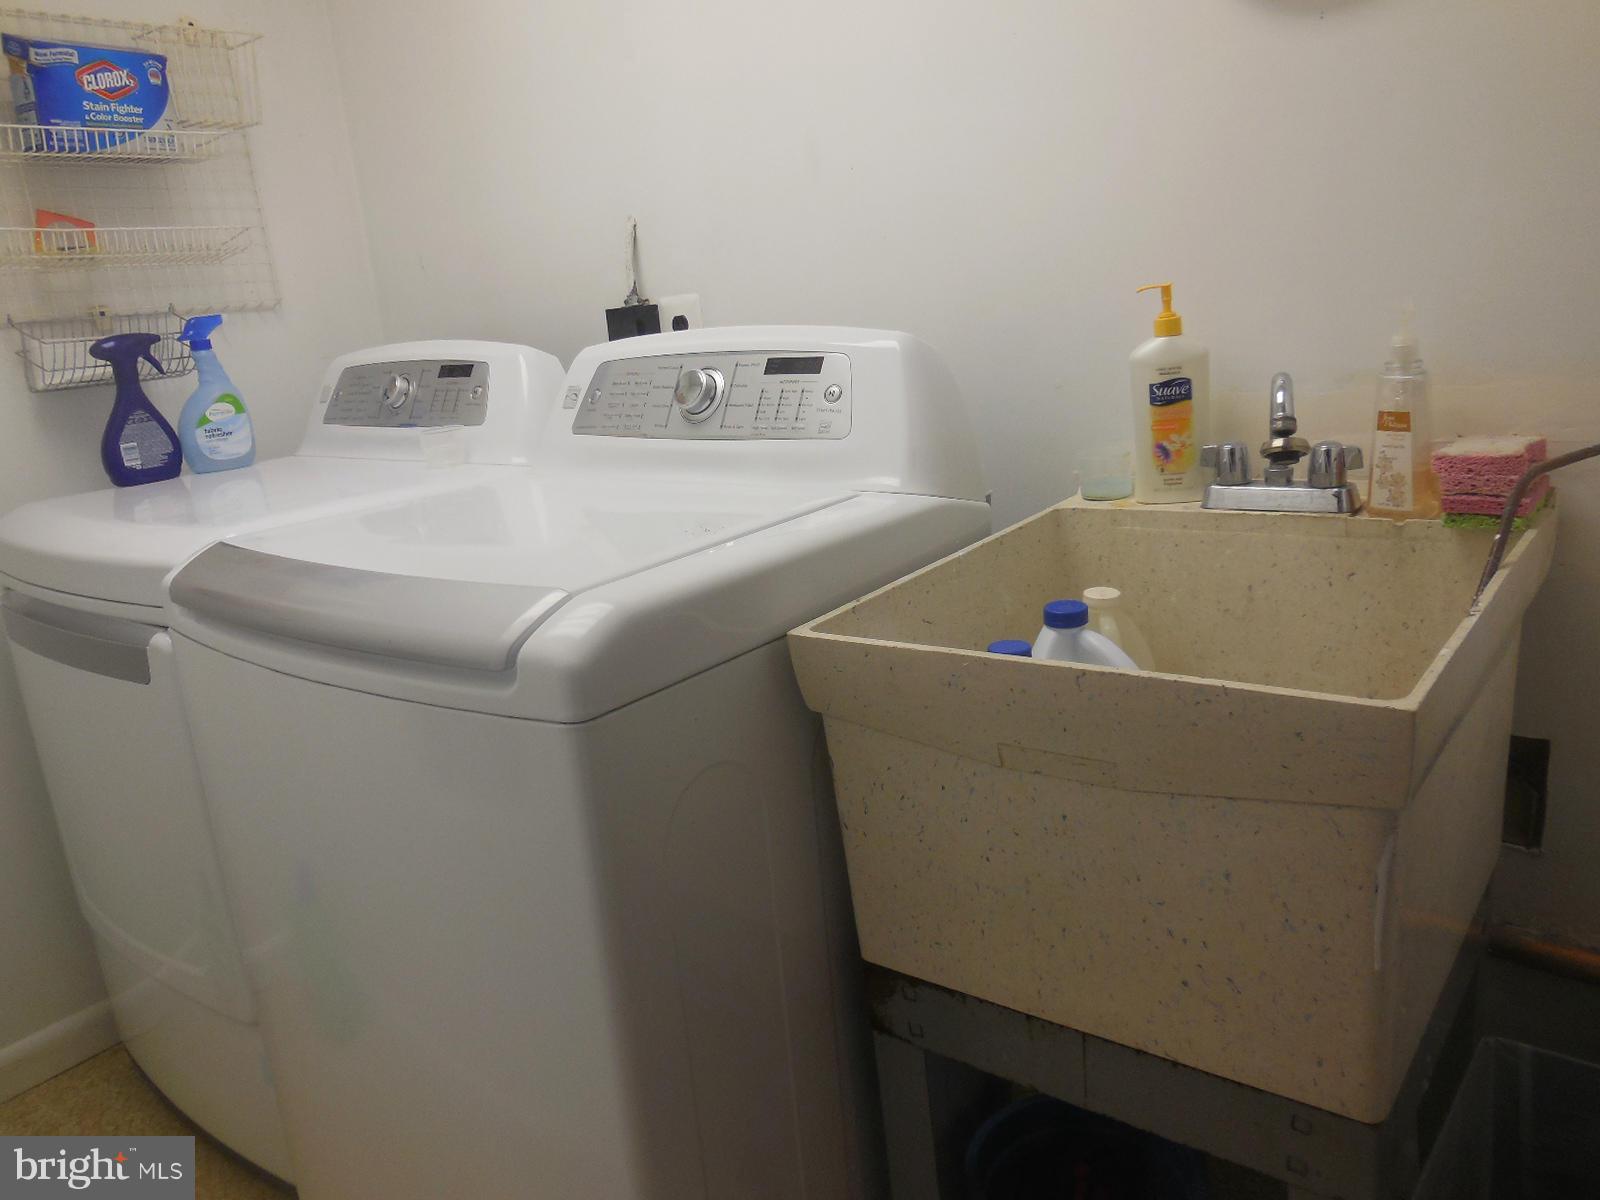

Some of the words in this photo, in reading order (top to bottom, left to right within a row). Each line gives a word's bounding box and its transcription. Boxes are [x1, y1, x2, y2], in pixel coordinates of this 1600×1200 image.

[82, 101, 110, 112] Stain
[110, 103, 144, 115] Fighter
[90, 112, 112, 121] Color
[113, 114, 144, 123] Booster
[1151, 384, 1190, 397] Suave
